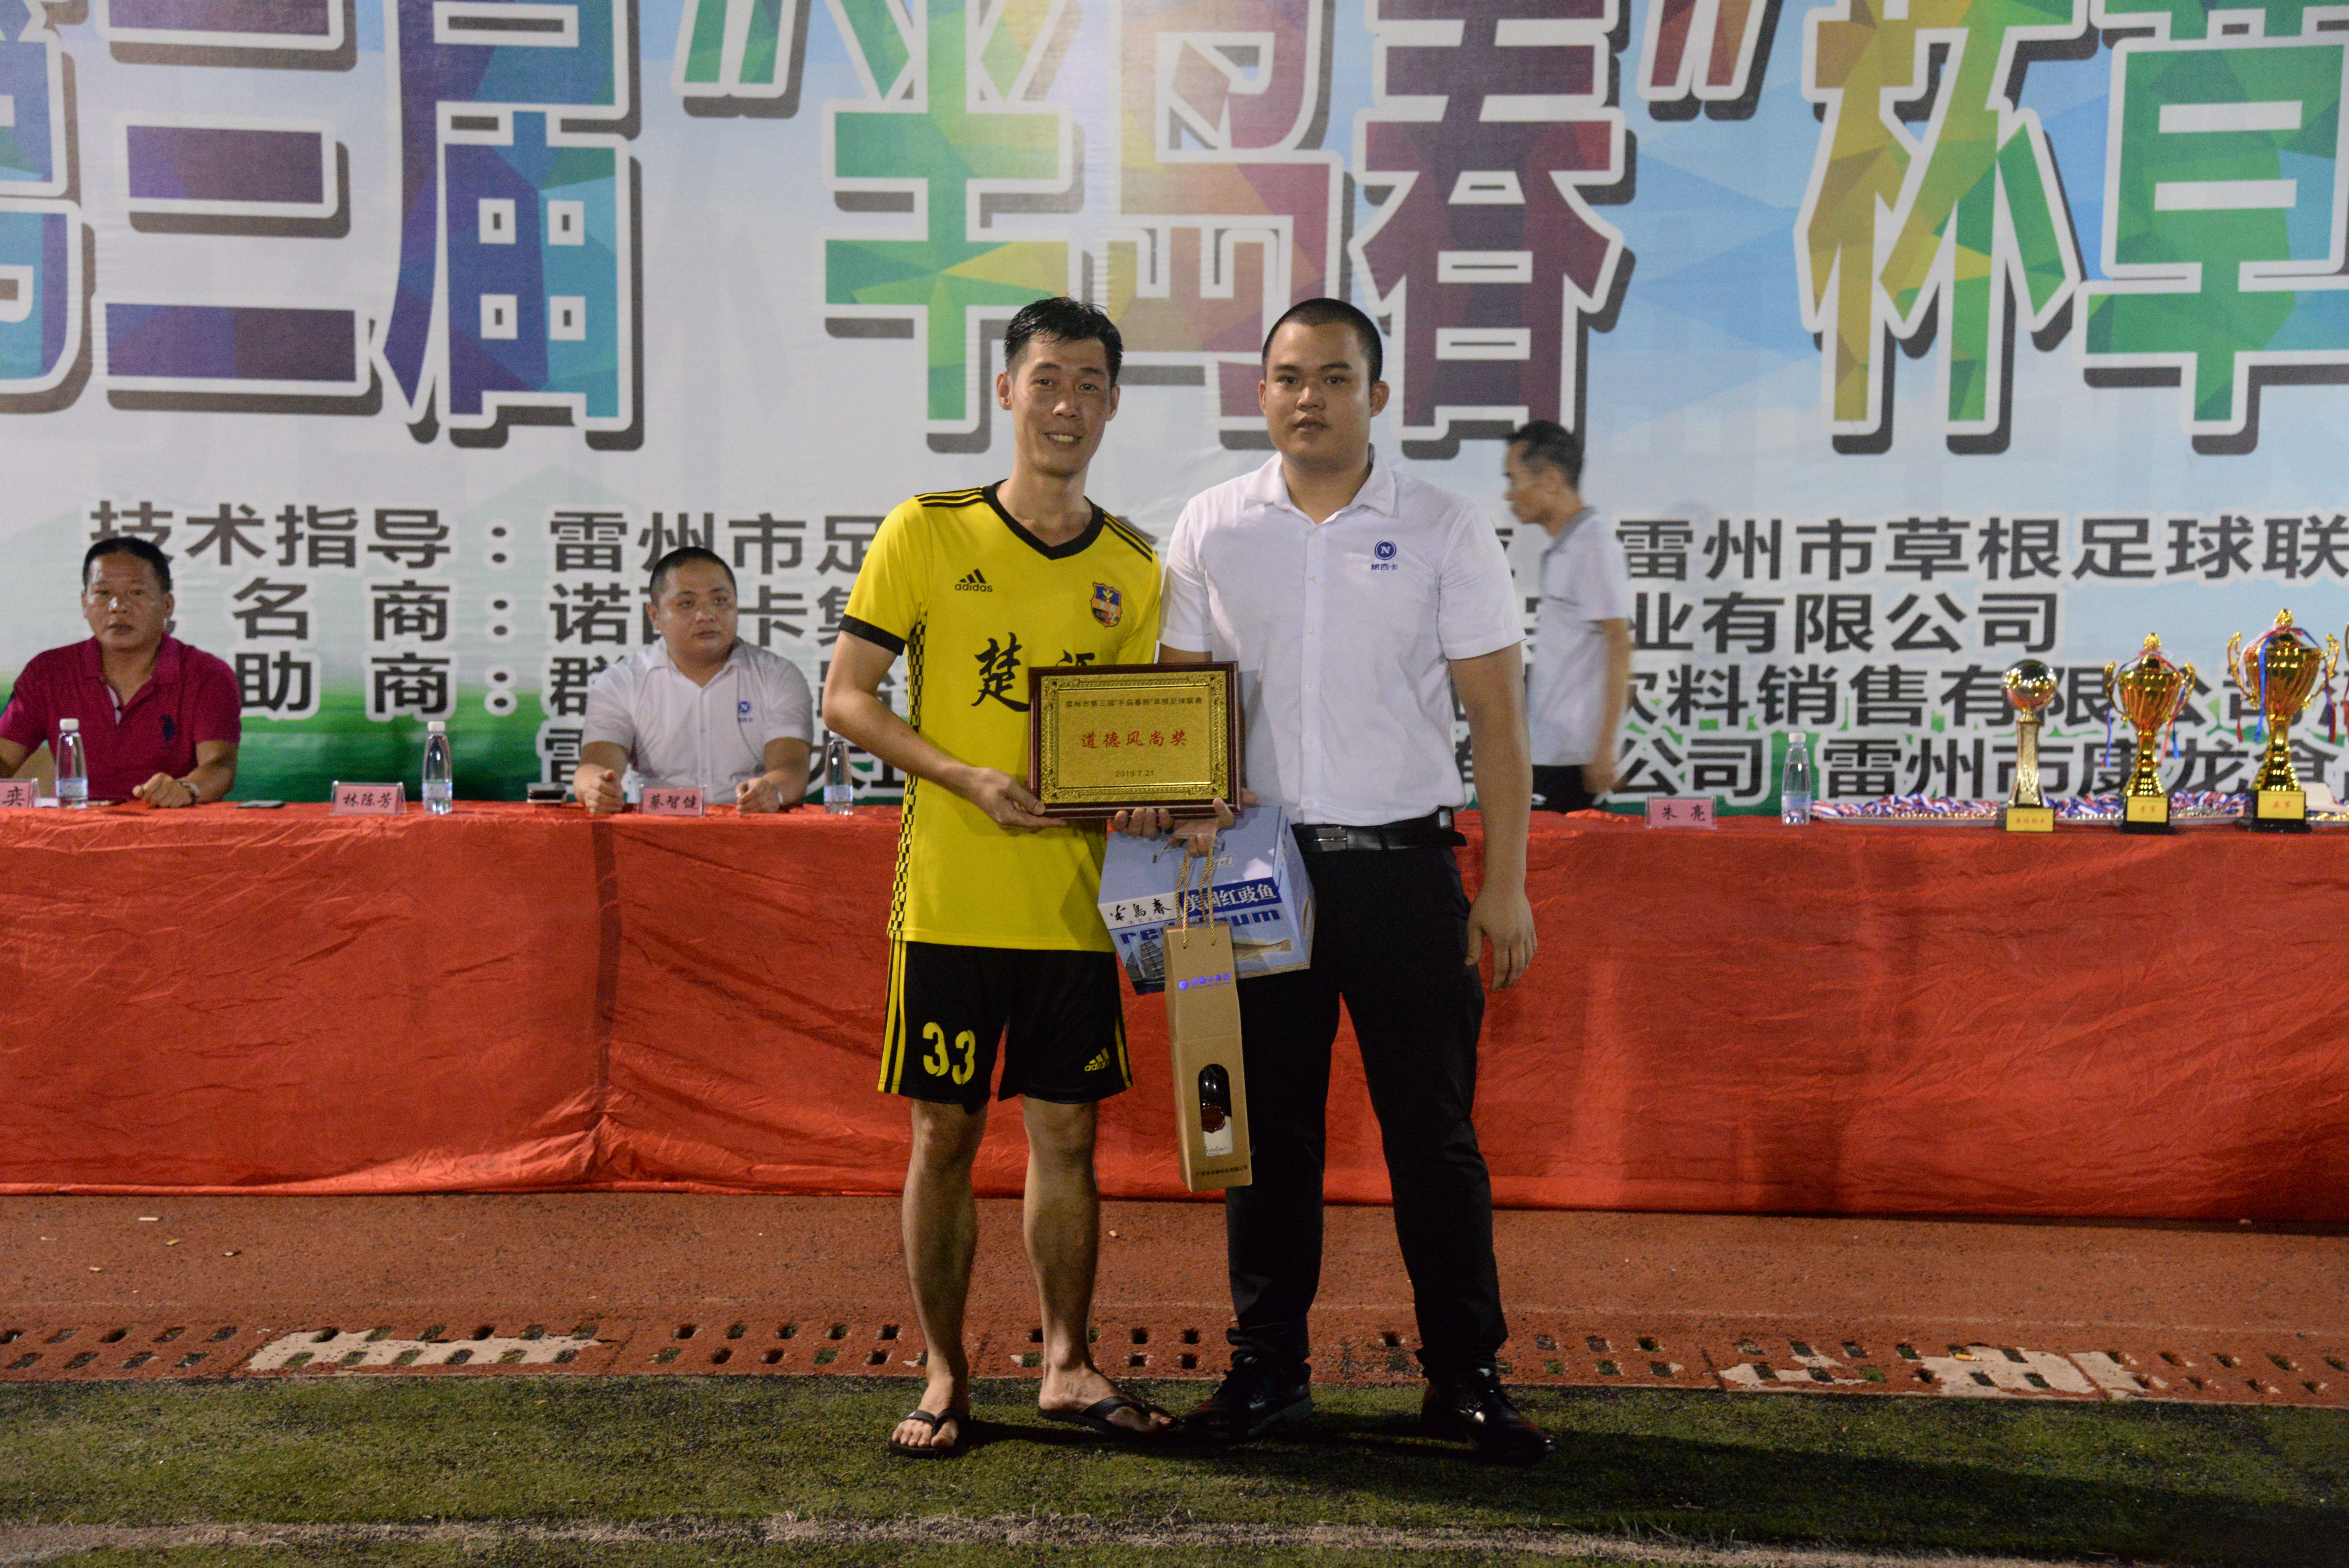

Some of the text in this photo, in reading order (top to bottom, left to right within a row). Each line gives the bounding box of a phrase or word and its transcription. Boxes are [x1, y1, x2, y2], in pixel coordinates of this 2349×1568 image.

[1616, 515, 2349, 580] 雷州市草根足球联
[955, 583, 993, 592] adidas
[1081, 729, 1187, 748] 道德风尚奖
[339, 792, 392, 809] 林陈芳
[650, 794, 698, 810] 蔡智健
[923, 1021, 976, 1085] 33
